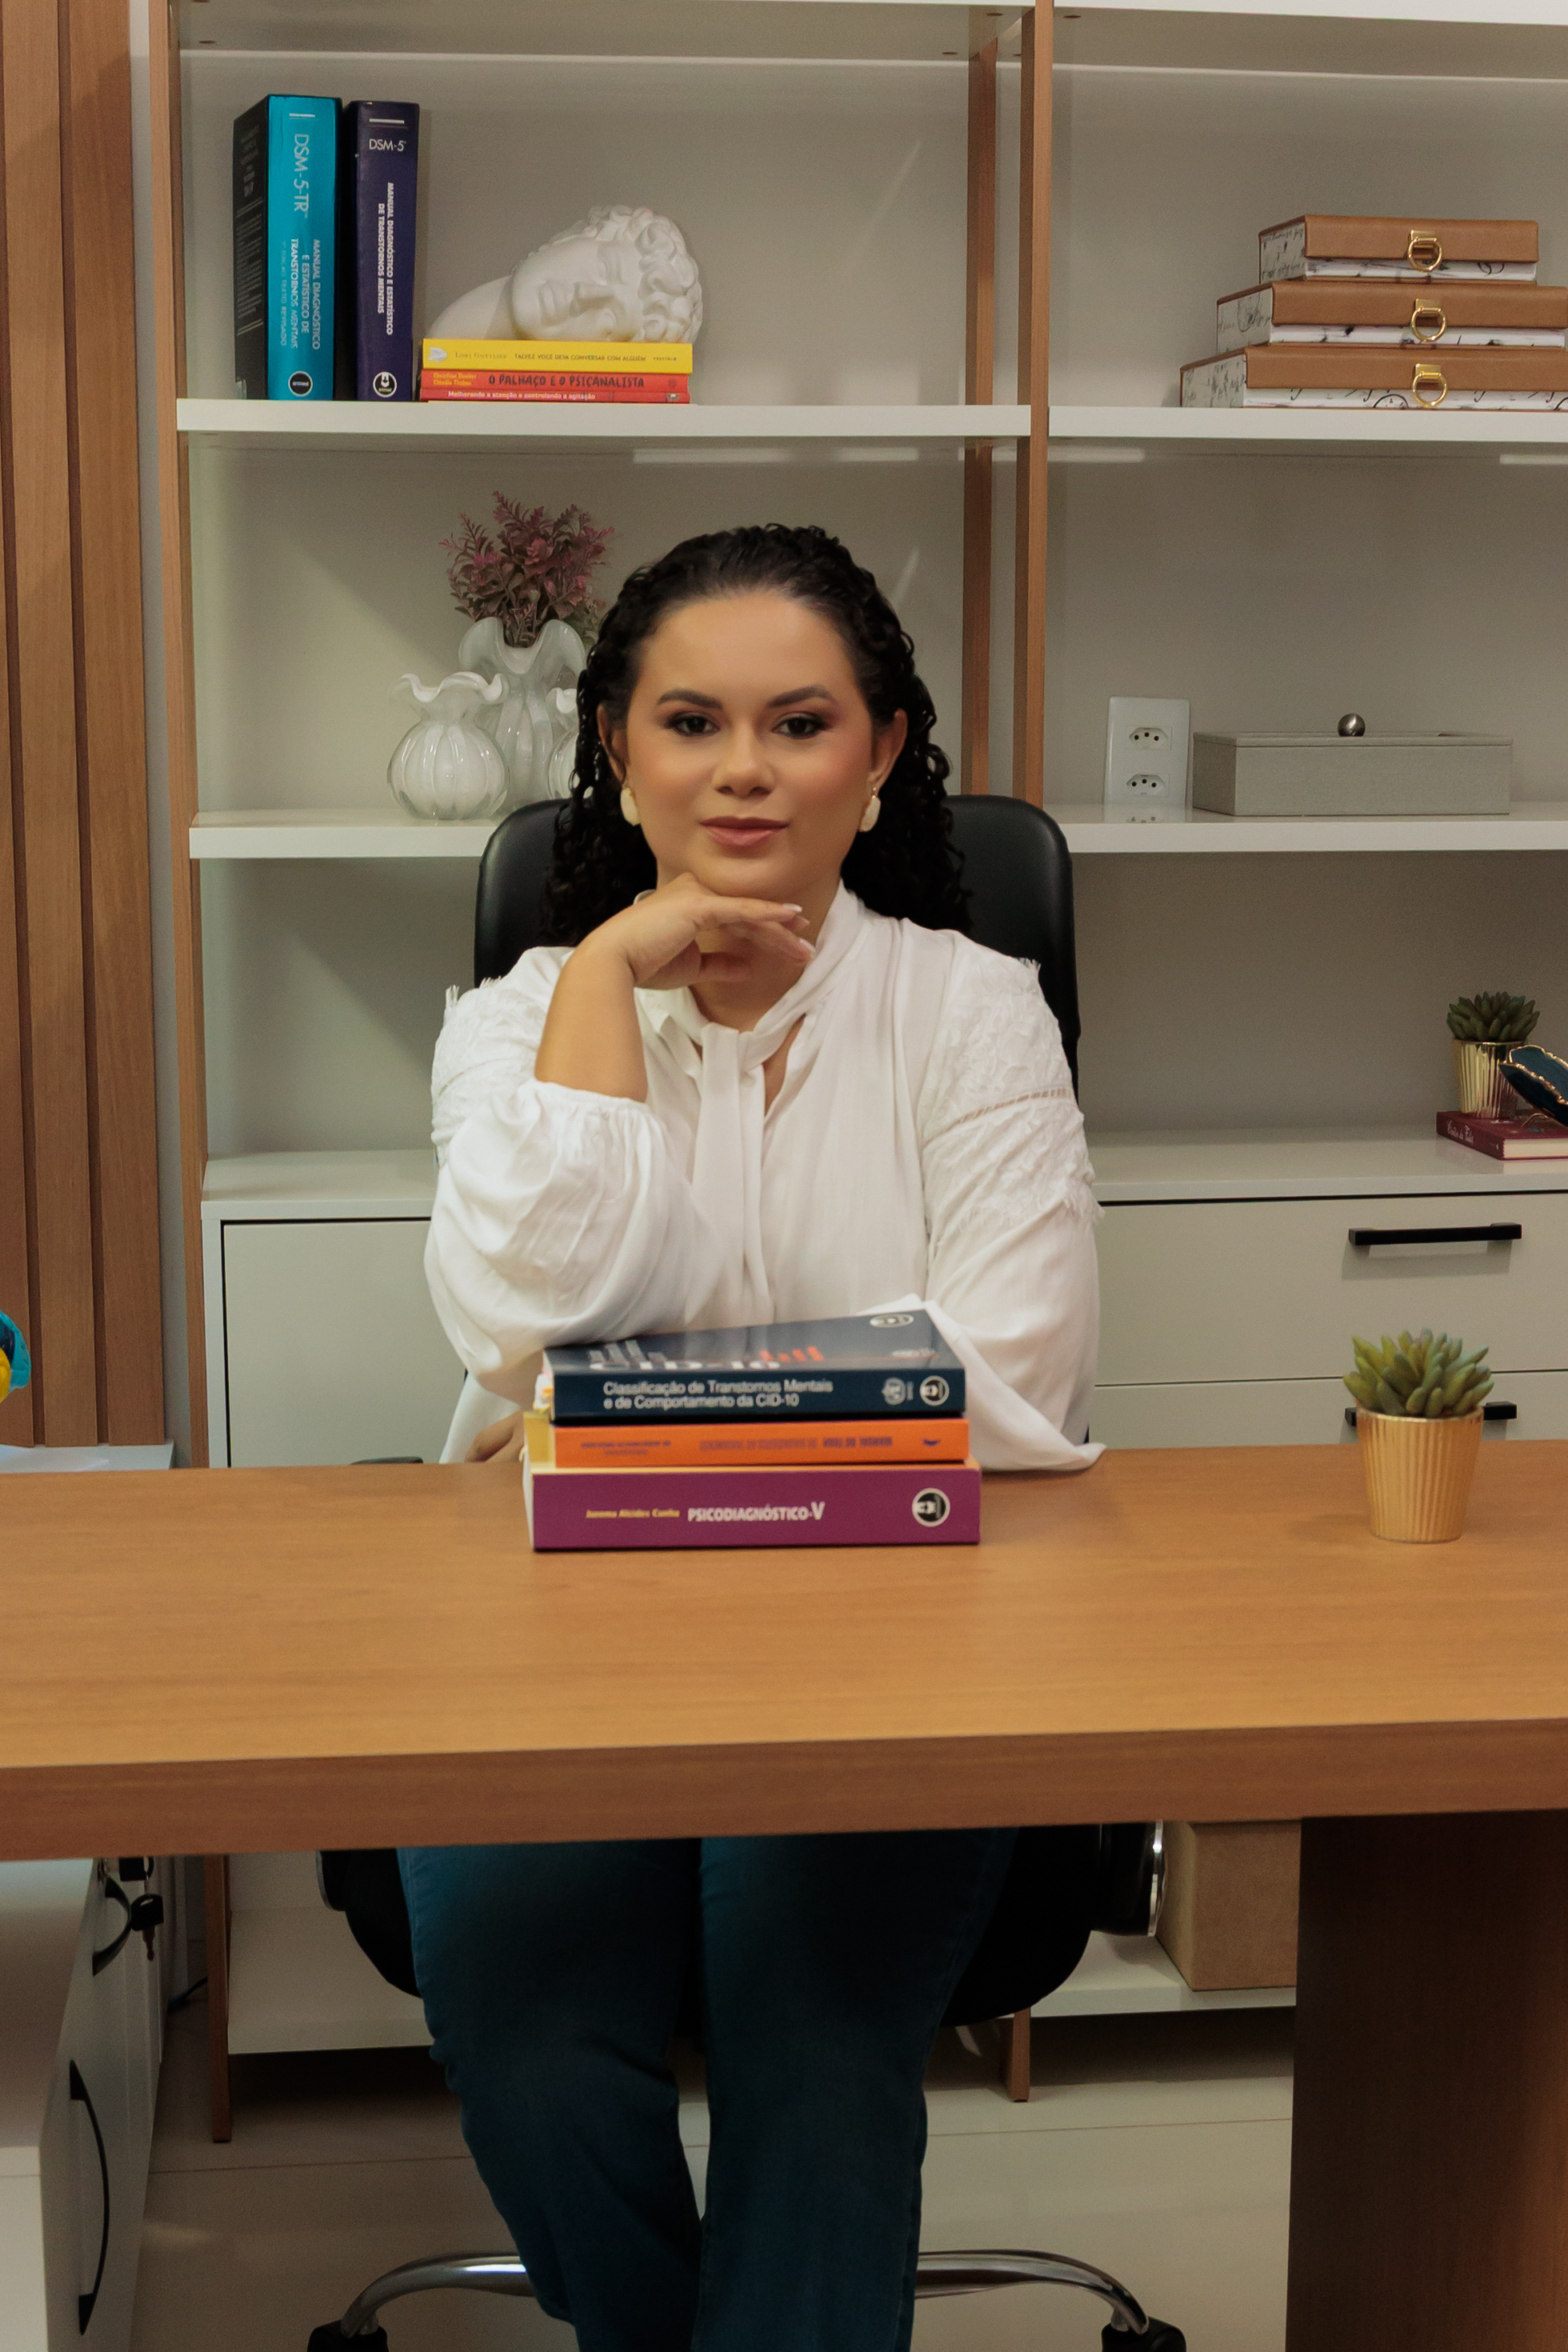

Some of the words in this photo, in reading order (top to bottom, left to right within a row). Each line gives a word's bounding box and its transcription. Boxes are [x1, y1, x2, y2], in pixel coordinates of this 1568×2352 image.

[378, 203, 385, 214] DE
[313, 239, 321, 280] MANUAL
[290, 238, 298, 307] TRANSTORNOS
[301, 320, 310, 334] DE
[489, 374, 495, 384] O
[499, 374, 546, 387] PALHAÇO
[550, 375, 556, 386] E
[559, 376, 566, 385] O
[570, 375, 644, 387] PSICANALISTA
[603, 1380, 686, 1397] Classificação
[687, 1382, 705, 1394] de
[707, 1379, 782, 1394] Transtornos
[783, 1378, 834, 1393] Mentais
[603, 1397, 613, 1409] e
[614, 1396, 632, 1410] de
[634, 1394, 735, 1410] Comportamento
[737, 1394, 754, 1408] da
[756, 1392, 799, 1407] CID-10
